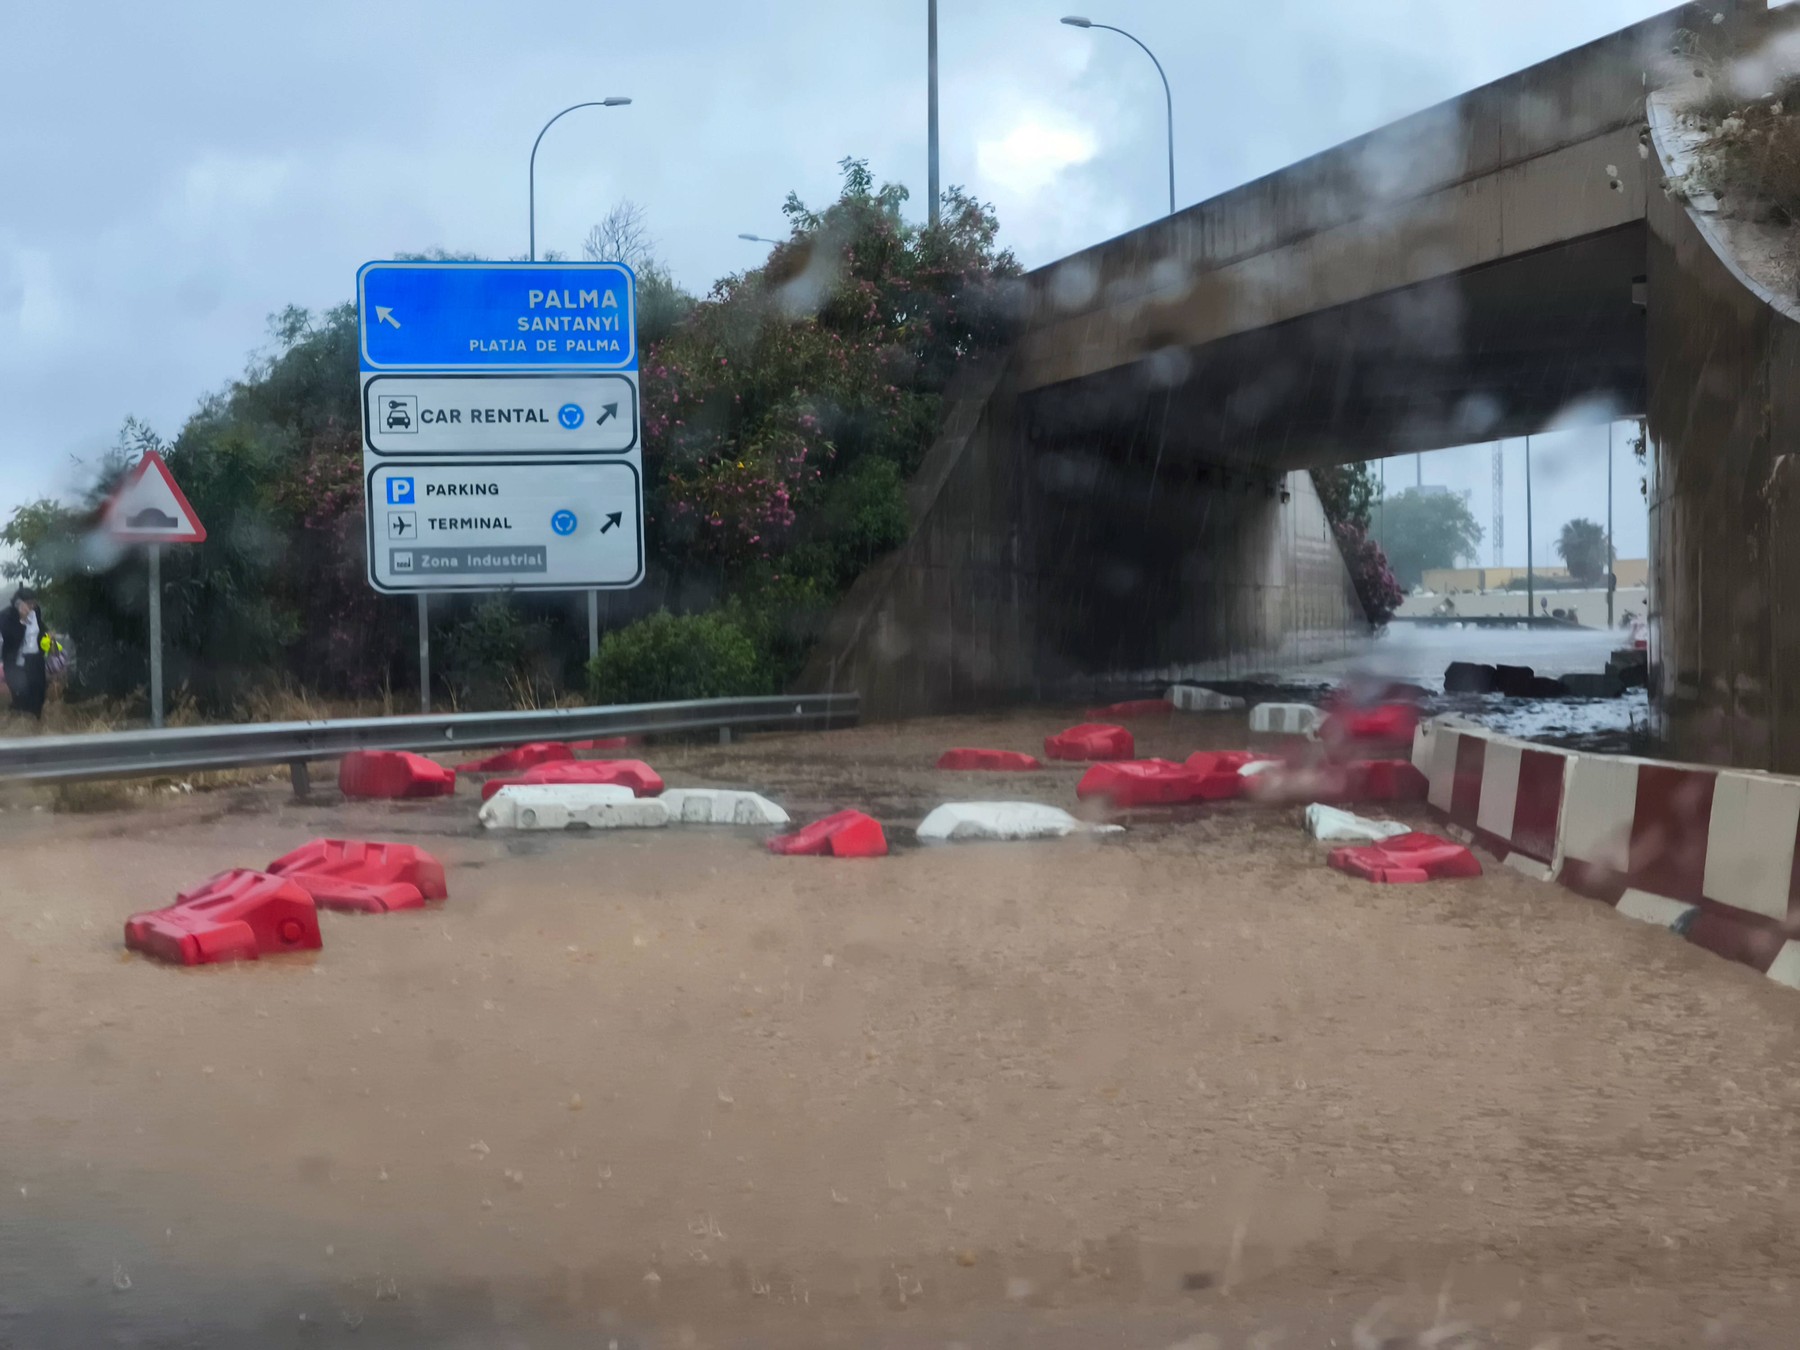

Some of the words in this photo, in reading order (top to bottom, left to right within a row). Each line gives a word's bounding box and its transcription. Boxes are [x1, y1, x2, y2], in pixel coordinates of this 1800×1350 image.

[528, 289, 618, 309] PALMA
[469, 339, 527, 352] PLATJA
[536, 339, 557, 352] DE
[566, 339, 620, 352] PALMA
[420, 409, 462, 424] CAR
[470, 408, 550, 424] RENTAL
[391, 479, 411, 503] P
[426, 483, 499, 496] PARKING
[428, 517, 512, 530] TERMINAL
[421, 555, 458, 567] Zona
[467, 553, 543, 567] Industrial
